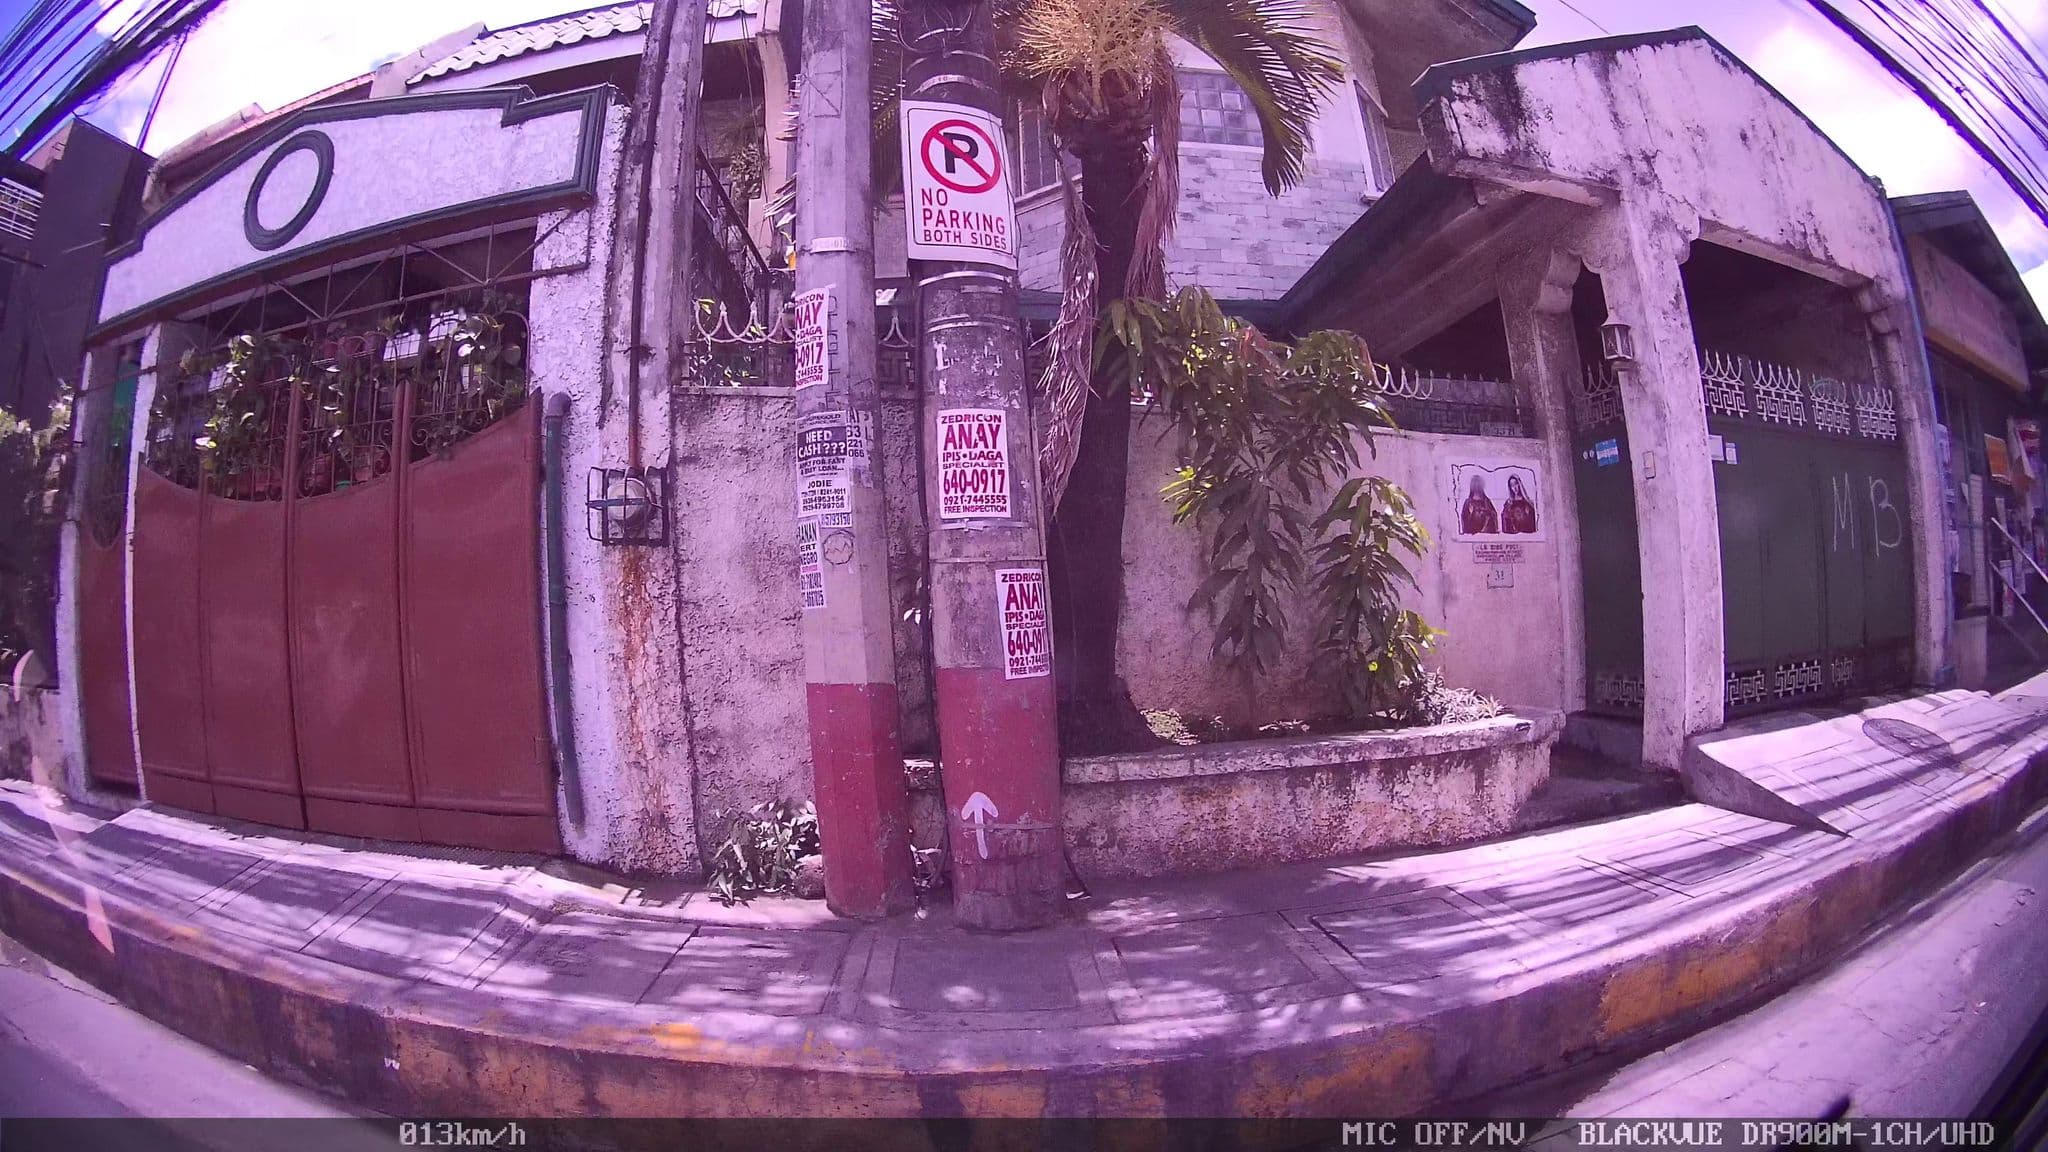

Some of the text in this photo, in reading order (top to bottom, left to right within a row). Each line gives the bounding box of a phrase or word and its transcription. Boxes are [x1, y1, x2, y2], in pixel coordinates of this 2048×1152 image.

[922, 188, 948, 206] NO
[923, 208, 1005, 235] PARKING
[924, 229, 1006, 250] BOTH SIDES
[941, 414, 1001, 424] ZEDRICON
[805, 430, 833, 444] NEED
[944, 424, 1000, 450] ANAY
[943, 461, 1004, 469] SPECIALIST
[808, 479, 833, 489] JODIE
[944, 469, 1005, 494] 640-0917
[944, 505, 1007, 514] FREE INSPECTION
[1010, 667, 1027, 676] FREE
